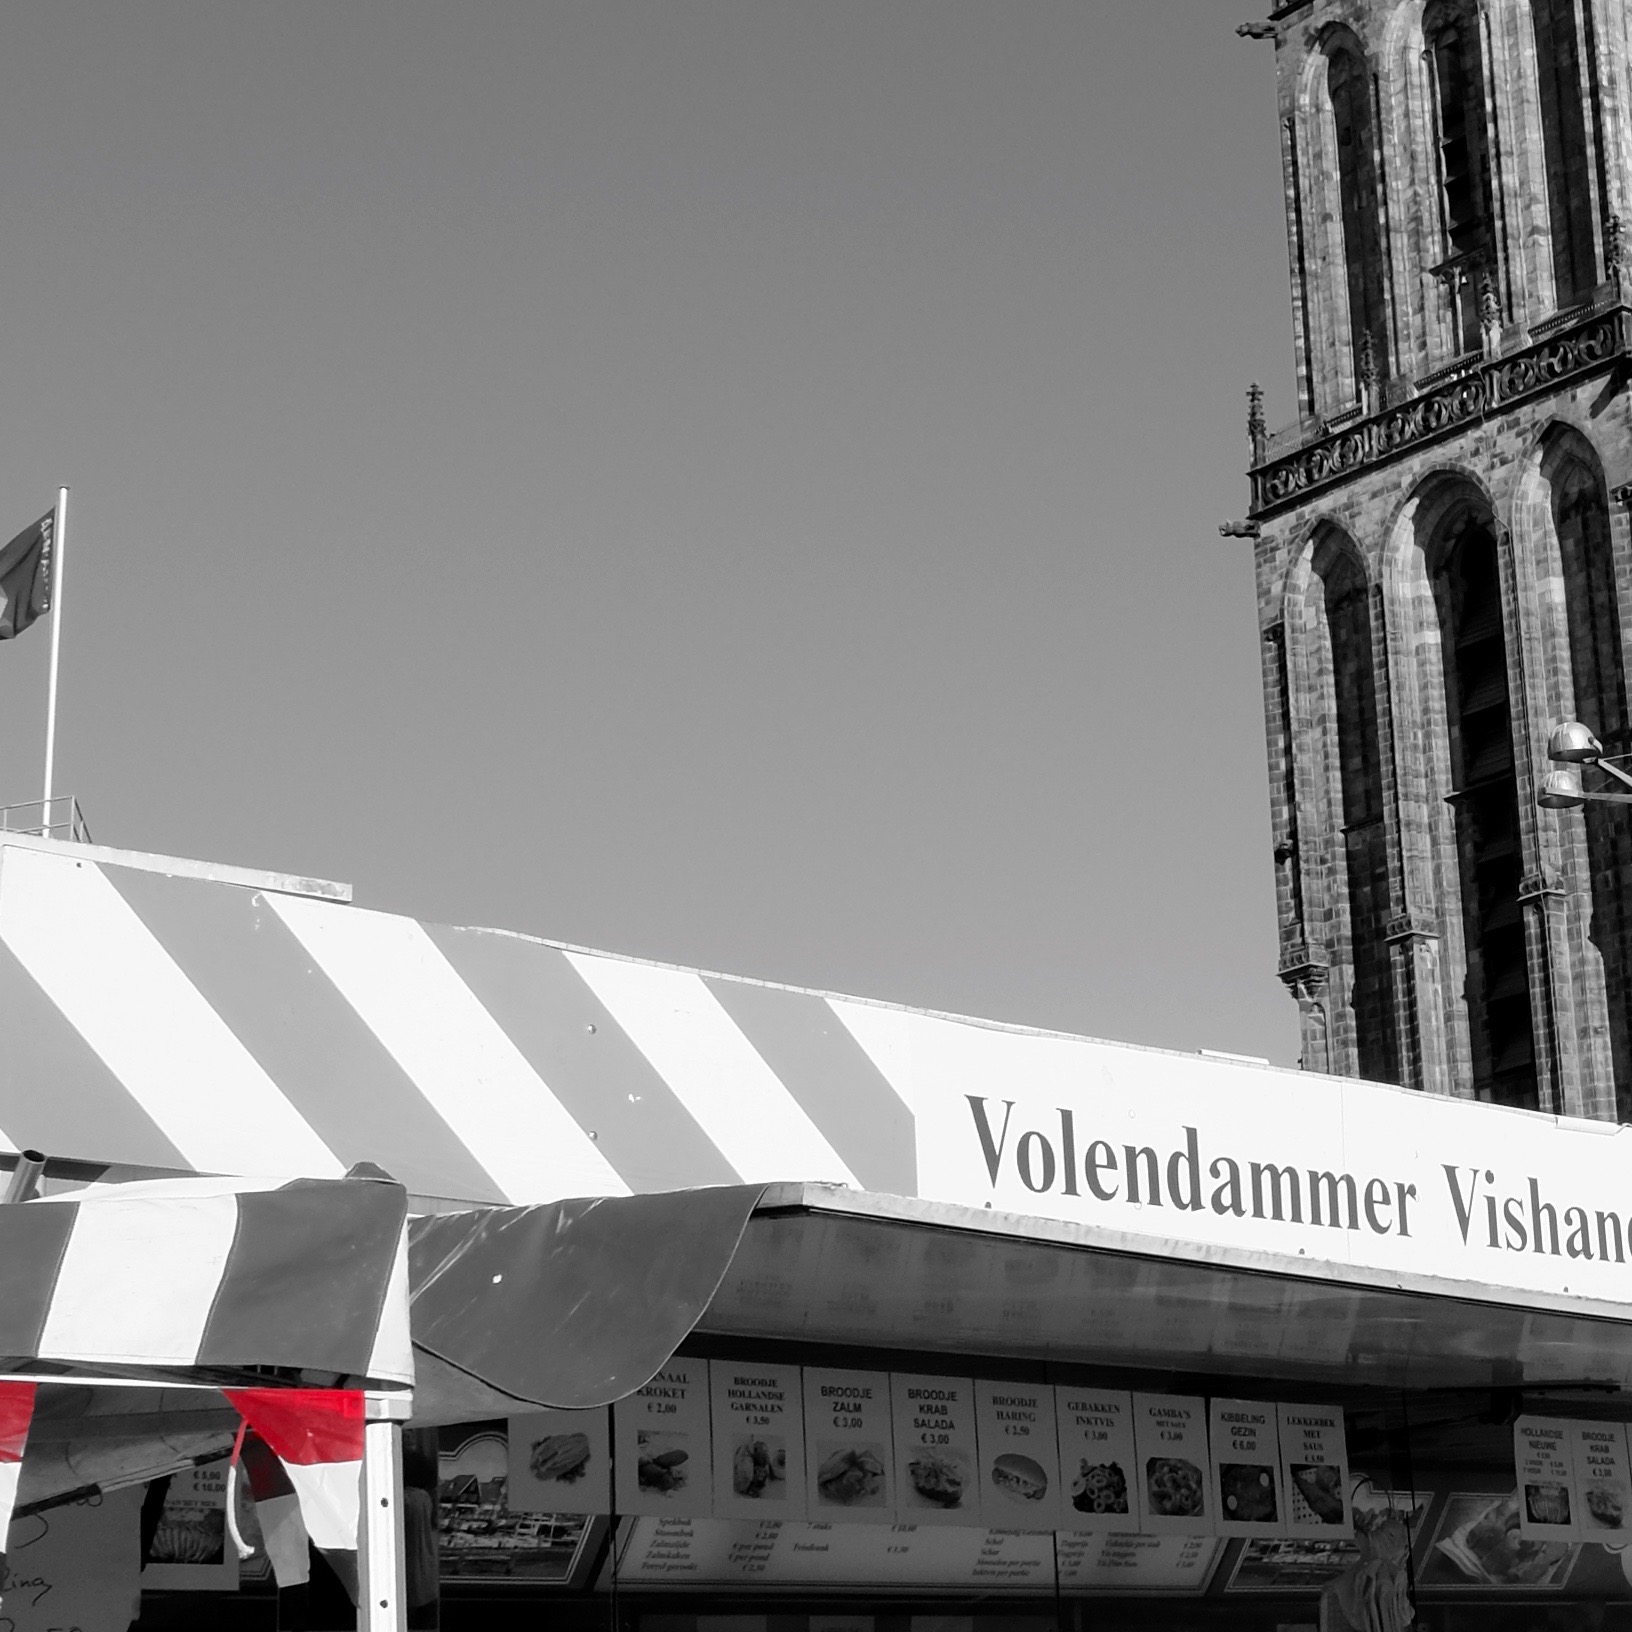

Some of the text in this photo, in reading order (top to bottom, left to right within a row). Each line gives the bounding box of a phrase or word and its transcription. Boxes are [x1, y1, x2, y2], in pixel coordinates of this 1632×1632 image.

[963, 1093, 1419, 1238] Volendammer
[733, 1376, 779, 1389] BROODJE
[727, 1388, 786, 1402] HOLLANDSE
[820, 1386, 873, 1400] BROODJE
[907, 1388, 958, 1402] BROODJE
[730, 1400, 785, 1414] GARNALEN
[832, 1402, 862, 1414] ZALM
[992, 1396, 1039, 1409] BROODJE
[1067, 1401, 1120, 1415] GEBAKKEN
[918, 1404, 949, 1417] KRAB
[996, 1410, 1036, 1423] HARING
[1149, 1407, 1192, 1420] GAMBA'S
[913, 1418, 956, 1431] SALADA
[1075, 1416, 1115, 1428] INKTVIS
[1220, 1412, 1266, 1425] KIBBELING
[1286, 1416, 1336, 1428] LEKKERBEK
[1230, 1426, 1257, 1438] GEZIN
[1302, 1429, 1321, 1440] MET
[1582, 1431, 1616, 1443] BROODJE
[1303, 1441, 1324, 1452] SAUS
[1589, 1444, 1610, 1454] KRAB
[1586, 1455, 1616, 1466] SALADA
